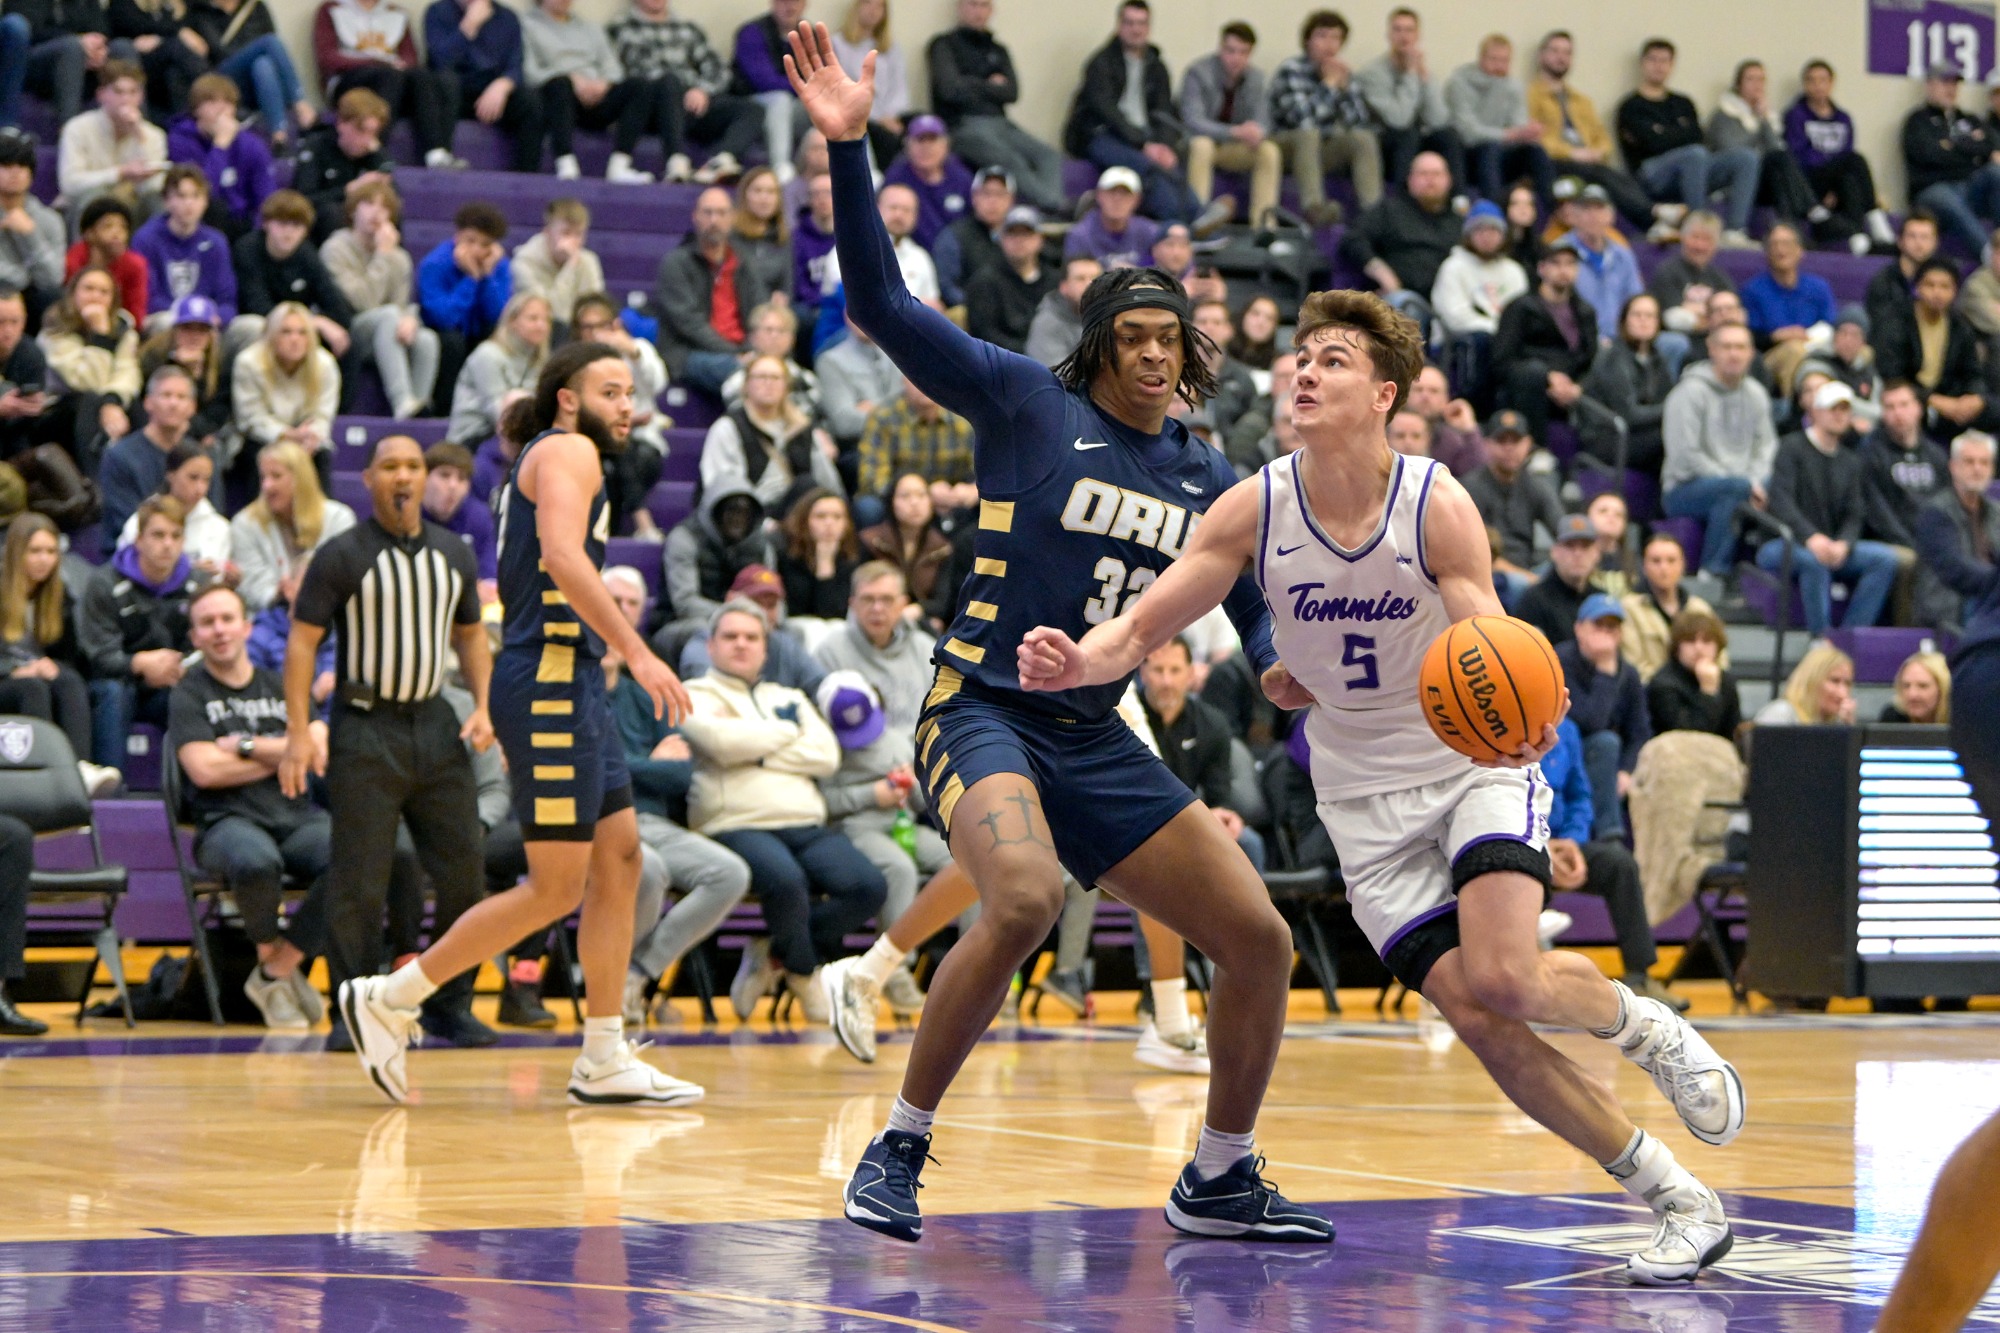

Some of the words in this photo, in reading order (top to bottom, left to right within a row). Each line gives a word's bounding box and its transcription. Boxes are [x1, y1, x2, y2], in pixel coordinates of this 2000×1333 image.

[1906, 20, 1979, 80] 113
[1060, 477, 1204, 561] ORU
[1287, 582, 1419, 622] Tommies
[1341, 632, 1380, 691] 5
[1458, 645, 1509, 739] Wilson
